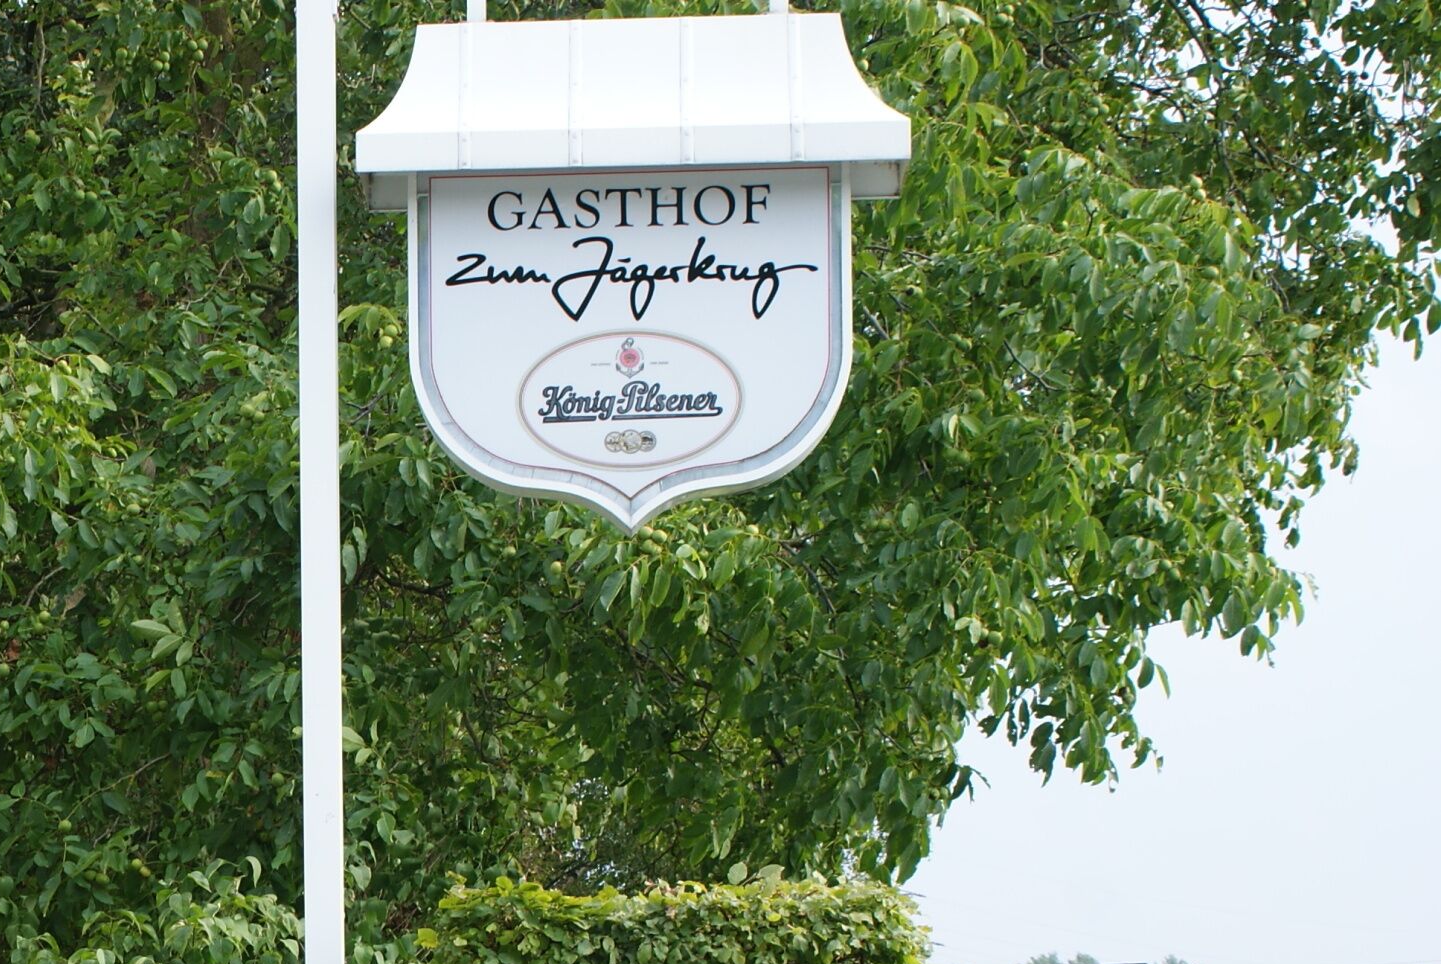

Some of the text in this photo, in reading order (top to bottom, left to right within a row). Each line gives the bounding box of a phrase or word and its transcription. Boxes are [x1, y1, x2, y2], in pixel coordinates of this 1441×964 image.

[487, 184, 771, 231] GASTHOF
[551, 236, 818, 321] Jägerkrug
[537, 380, 723, 424] König-Pilsener
